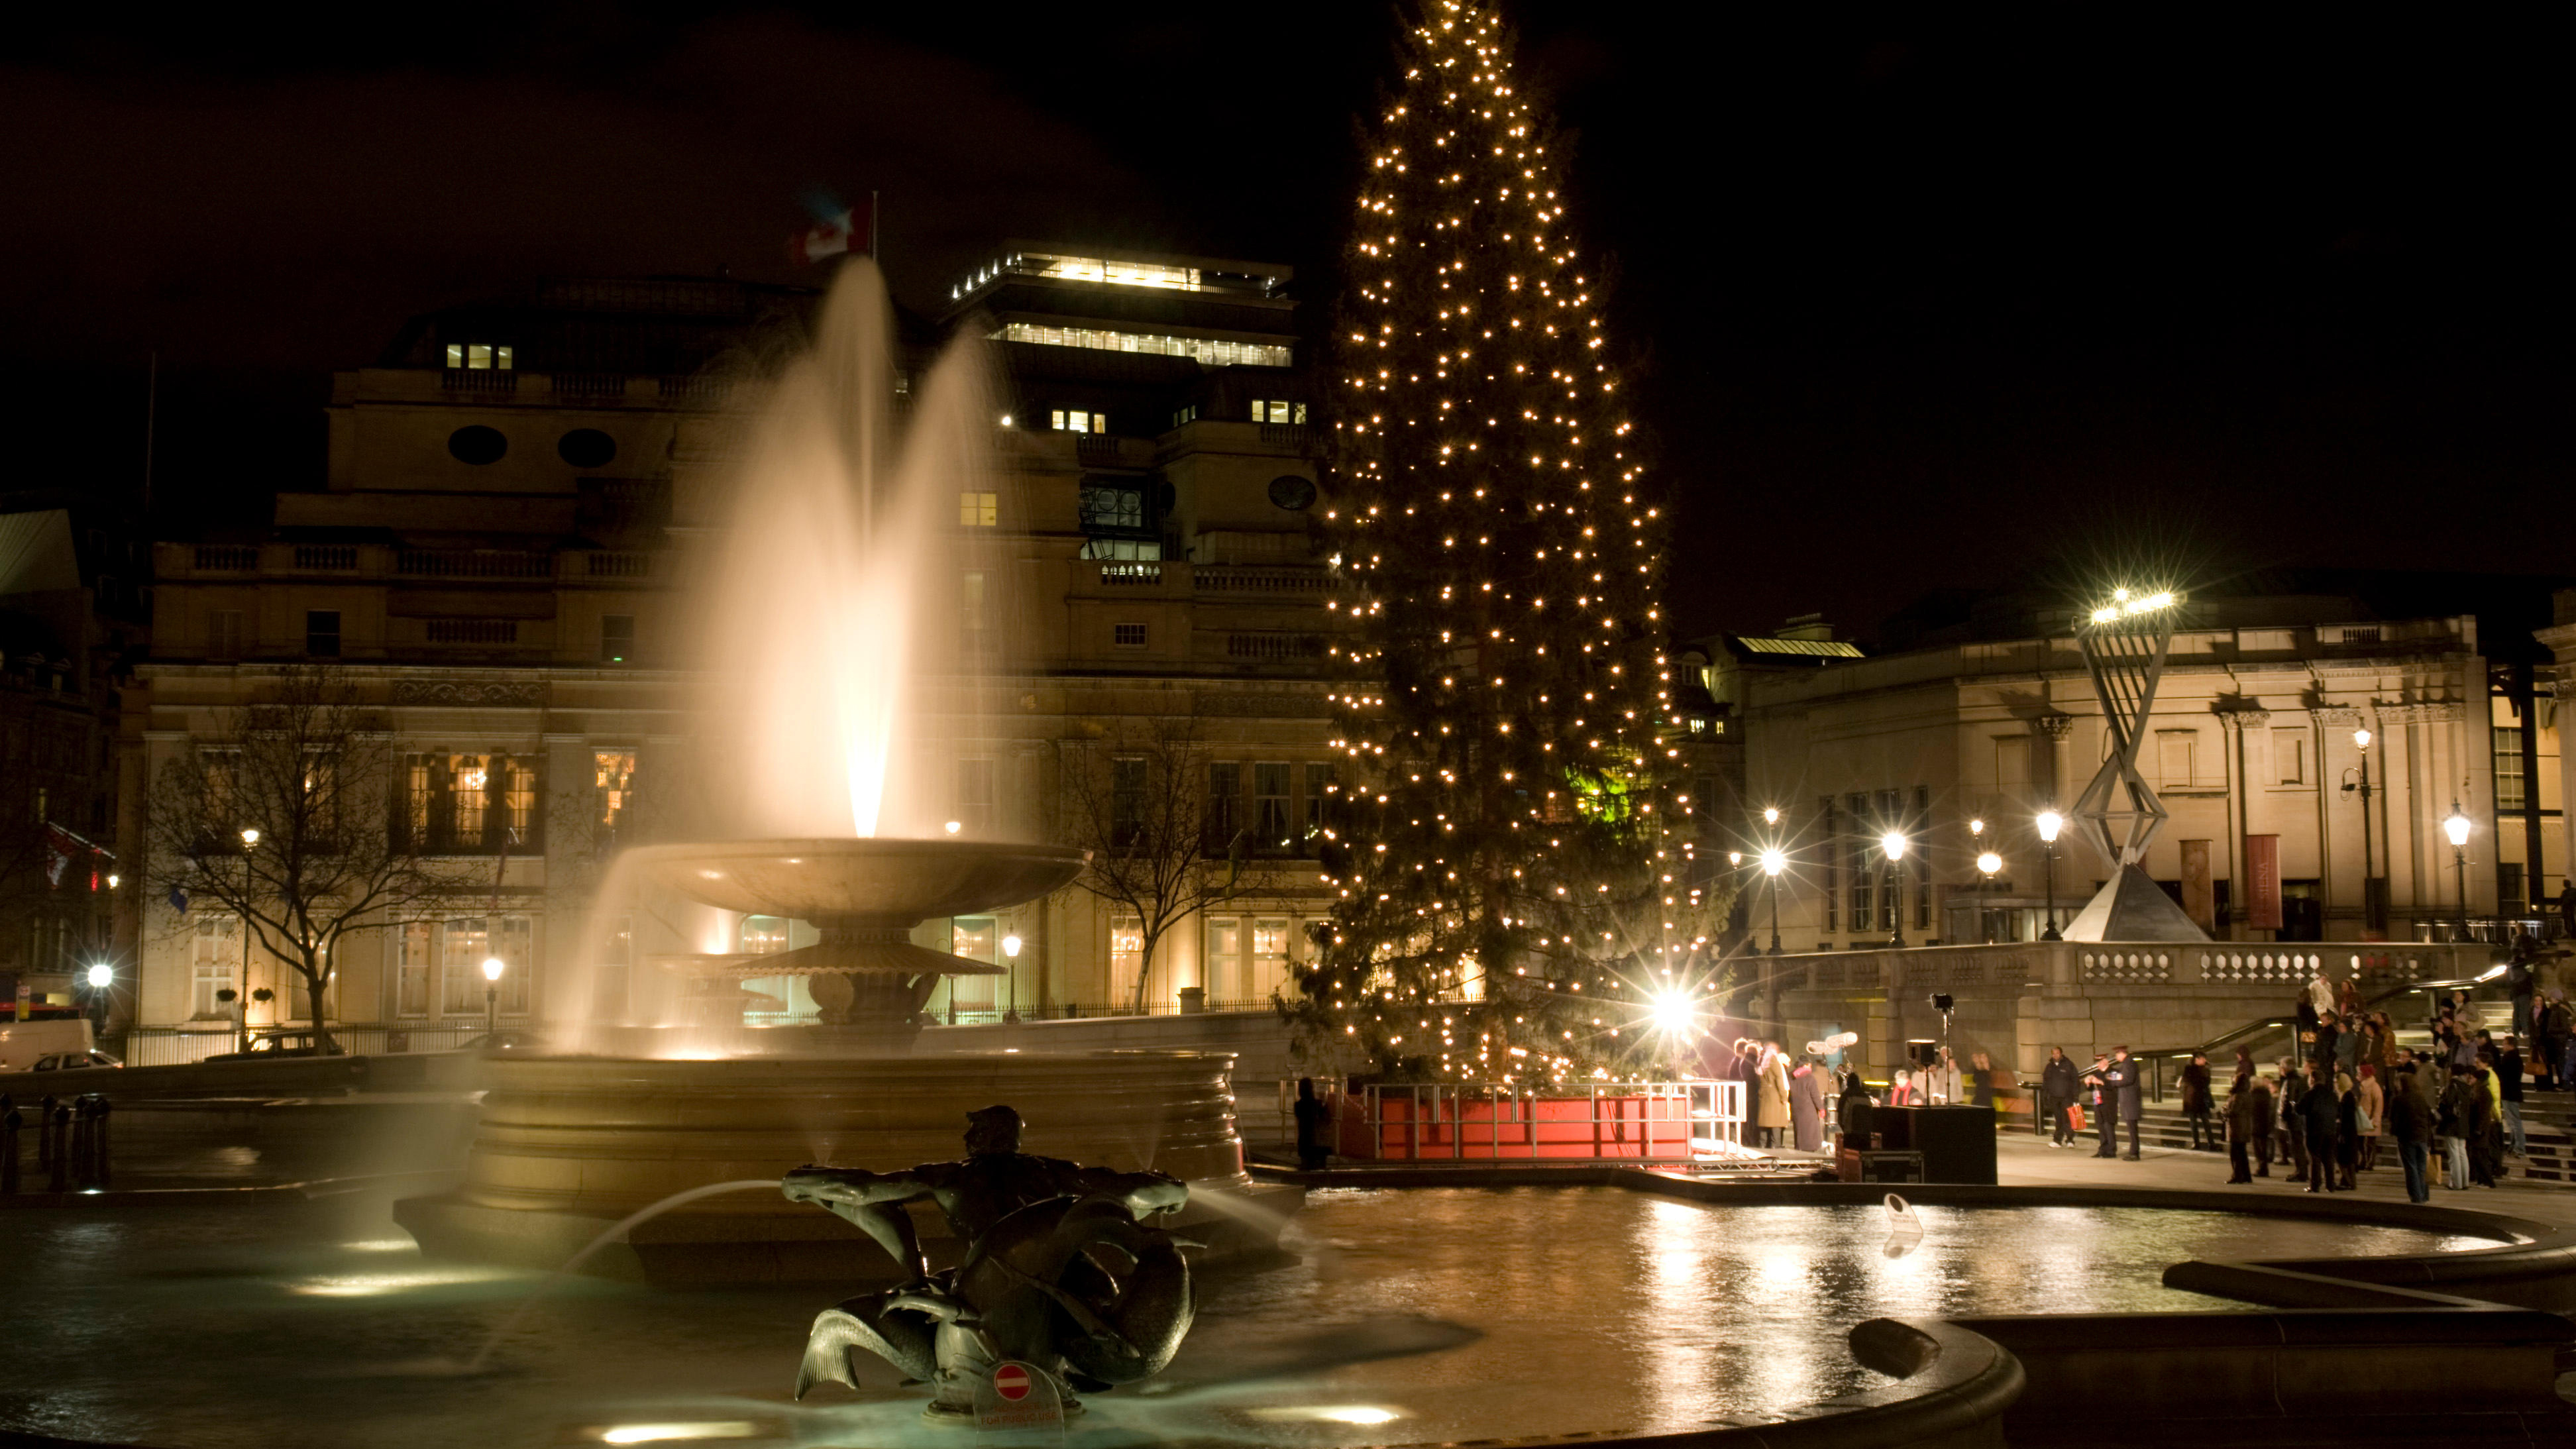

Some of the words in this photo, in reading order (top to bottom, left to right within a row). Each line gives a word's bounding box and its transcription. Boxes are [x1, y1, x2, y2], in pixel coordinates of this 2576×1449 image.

[981, 1416, 1000, 1426] FOR
[1002, 1413, 1036, 1424] PUBLIC
[1038, 1411, 1057, 1421] USE
